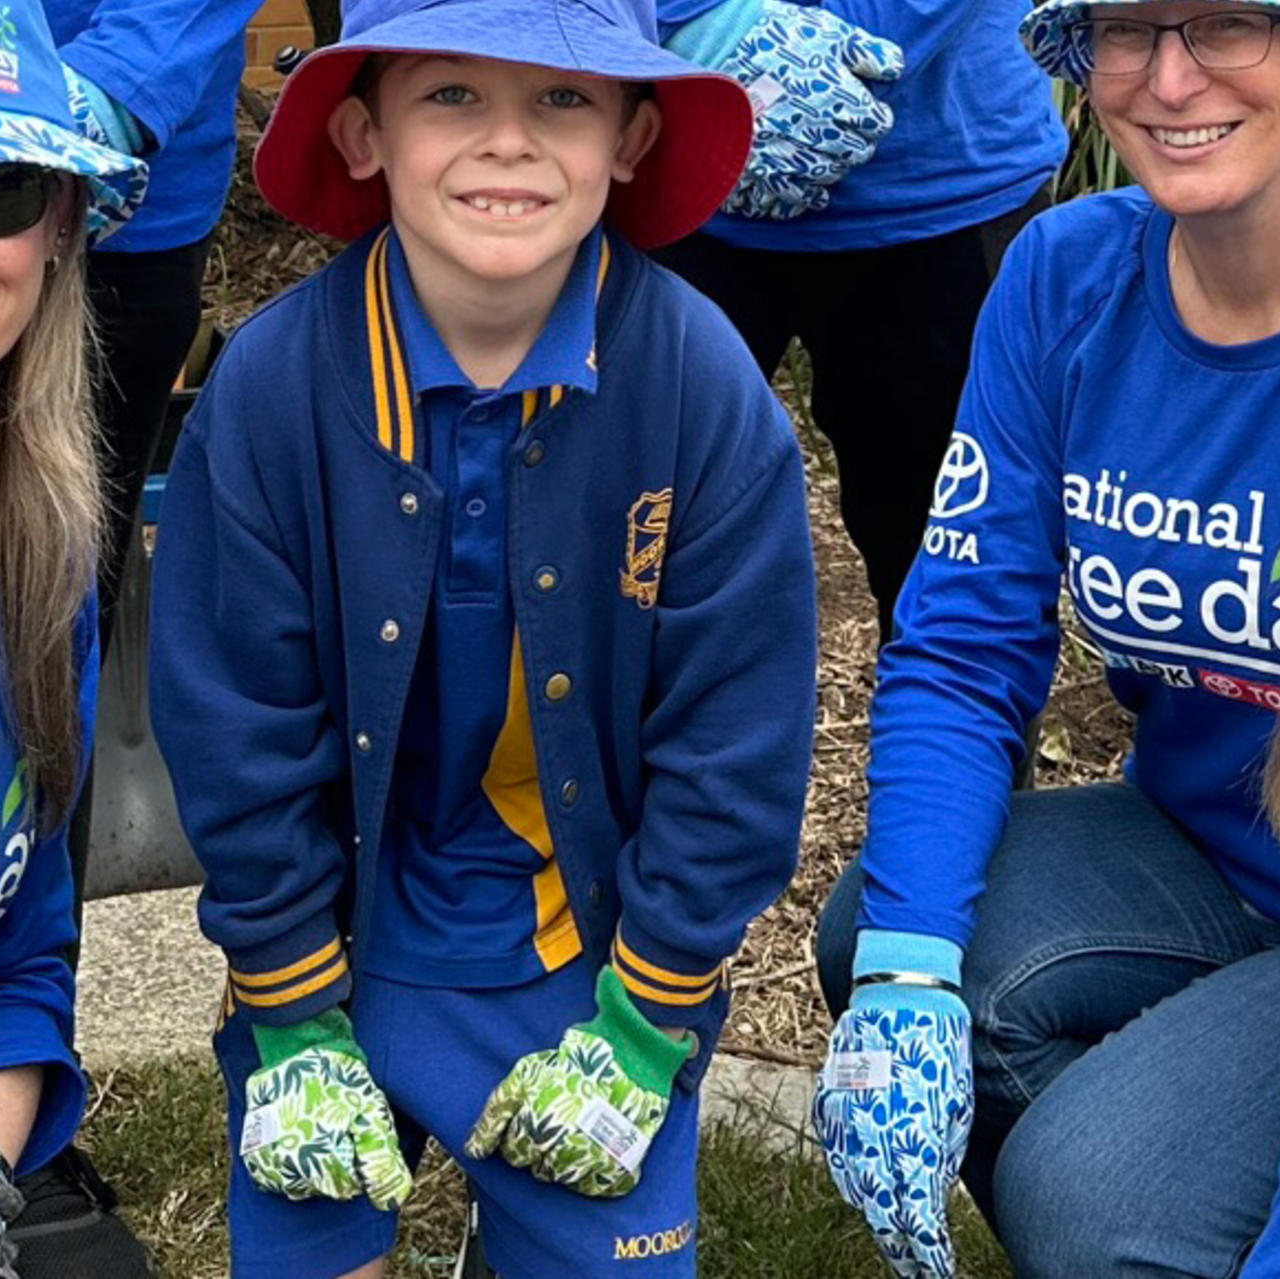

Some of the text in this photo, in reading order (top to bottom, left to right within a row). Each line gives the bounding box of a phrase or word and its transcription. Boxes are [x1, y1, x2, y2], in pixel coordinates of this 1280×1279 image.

[922, 524, 981, 565] YOTA
[1063, 468, 1265, 554] ational
[1067, 544, 1184, 633] ree
